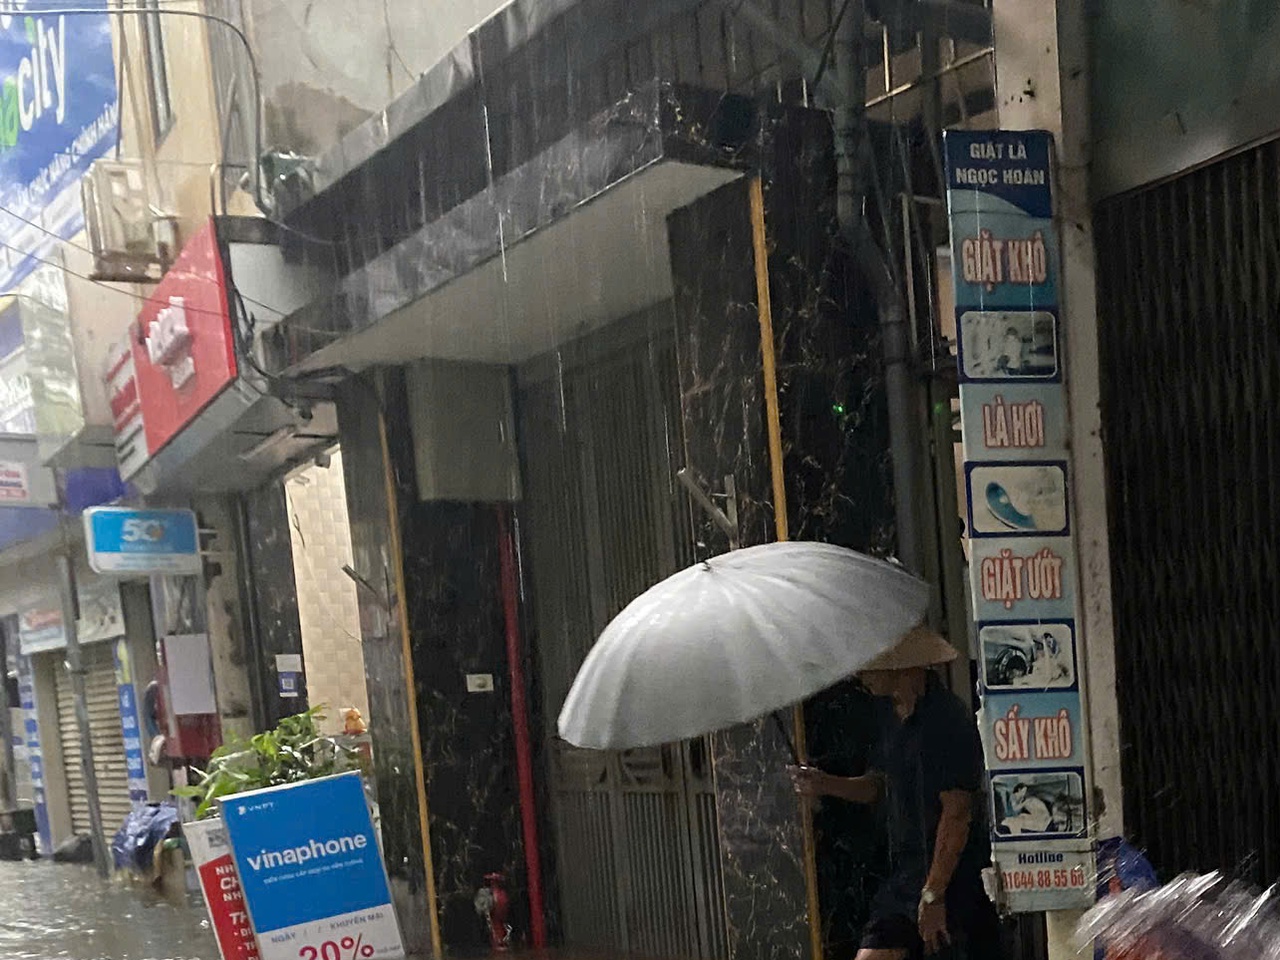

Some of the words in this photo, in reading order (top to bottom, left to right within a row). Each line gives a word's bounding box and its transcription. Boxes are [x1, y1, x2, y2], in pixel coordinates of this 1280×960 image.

[955, 167, 998, 187] NGỌC
[961, 229, 1003, 292] GIẶT
[983, 395, 1009, 447] LÀ
[981, 549, 1023, 608] GIẶT
[995, 704, 1030, 760] SẤY
[1033, 708, 1073, 759] KHÔ
[246, 834, 367, 871] vinaphone
[1018, 852, 1064, 864] Hotline
[1054, 869, 1068, 887] 55
